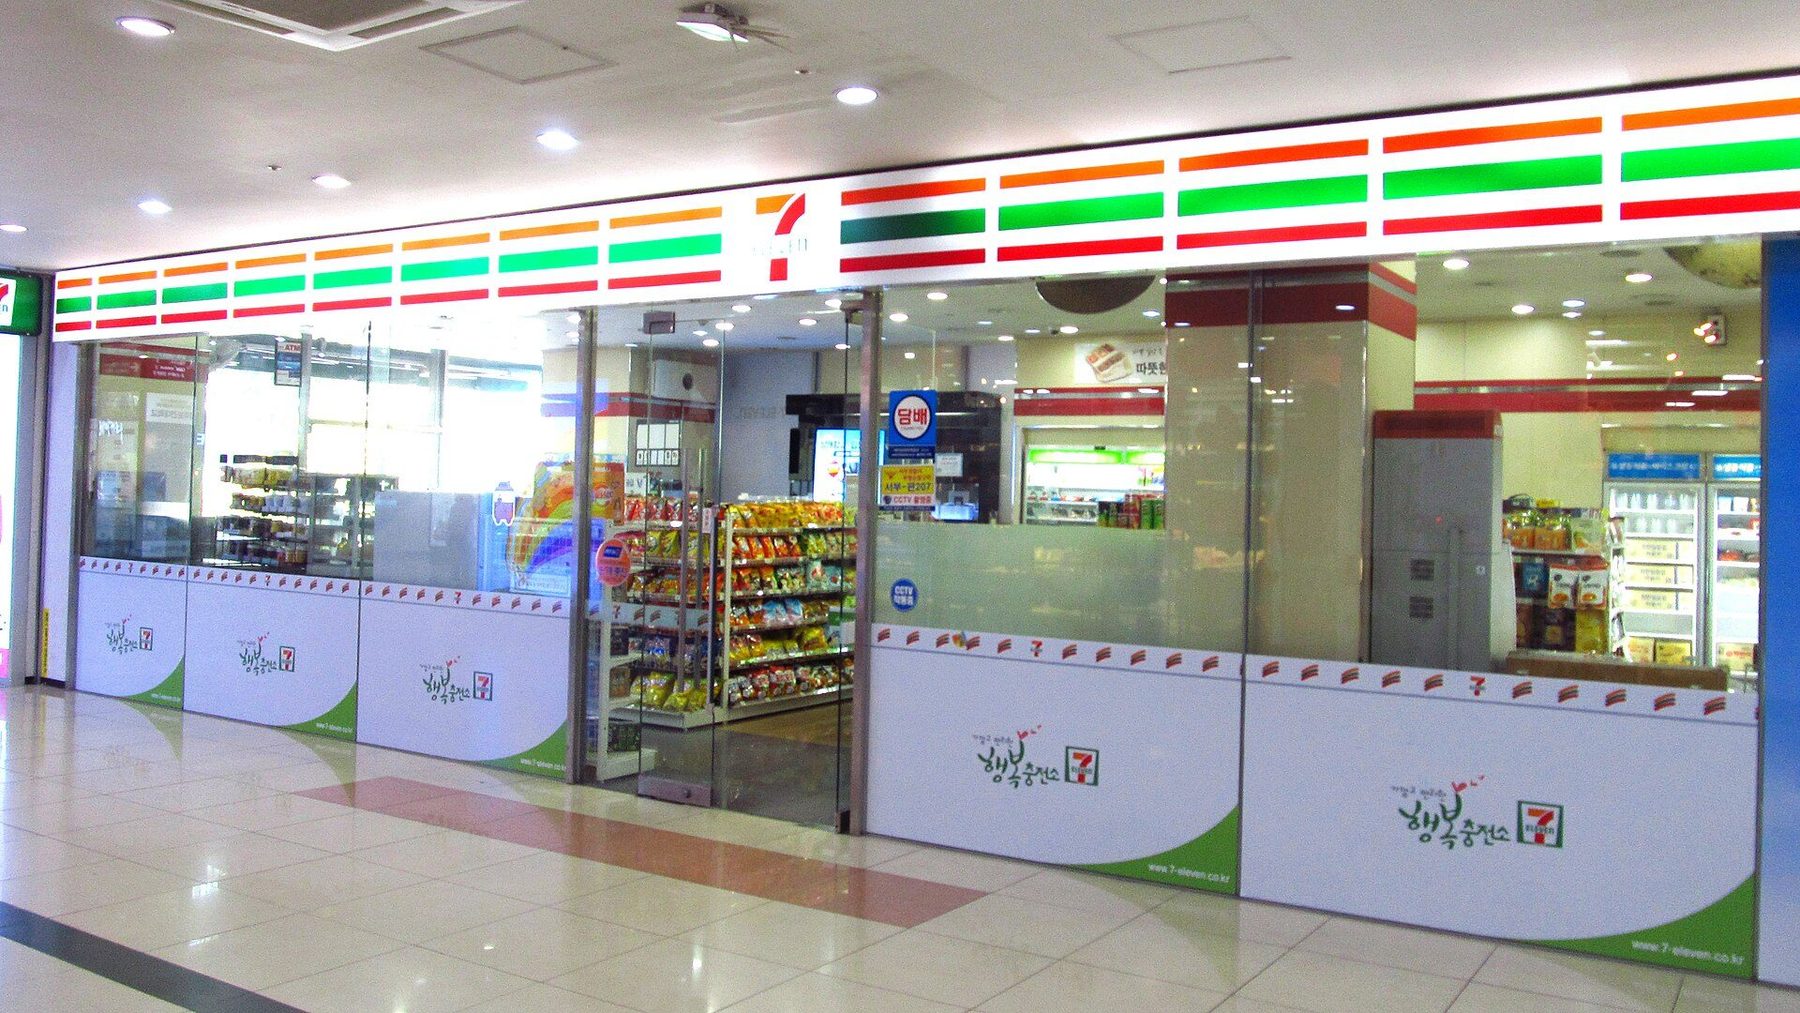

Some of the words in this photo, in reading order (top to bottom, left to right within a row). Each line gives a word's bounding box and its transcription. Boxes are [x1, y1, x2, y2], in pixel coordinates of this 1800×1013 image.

[756, 193, 805, 281] 7
[898, 408, 928, 426] 담배
[977, 740, 1060, 789] 행복충전소
[1072, 752, 1093, 784] 7
[1398, 793, 1511, 850] 행복충전소
[1527, 808, 1555, 844] 7
